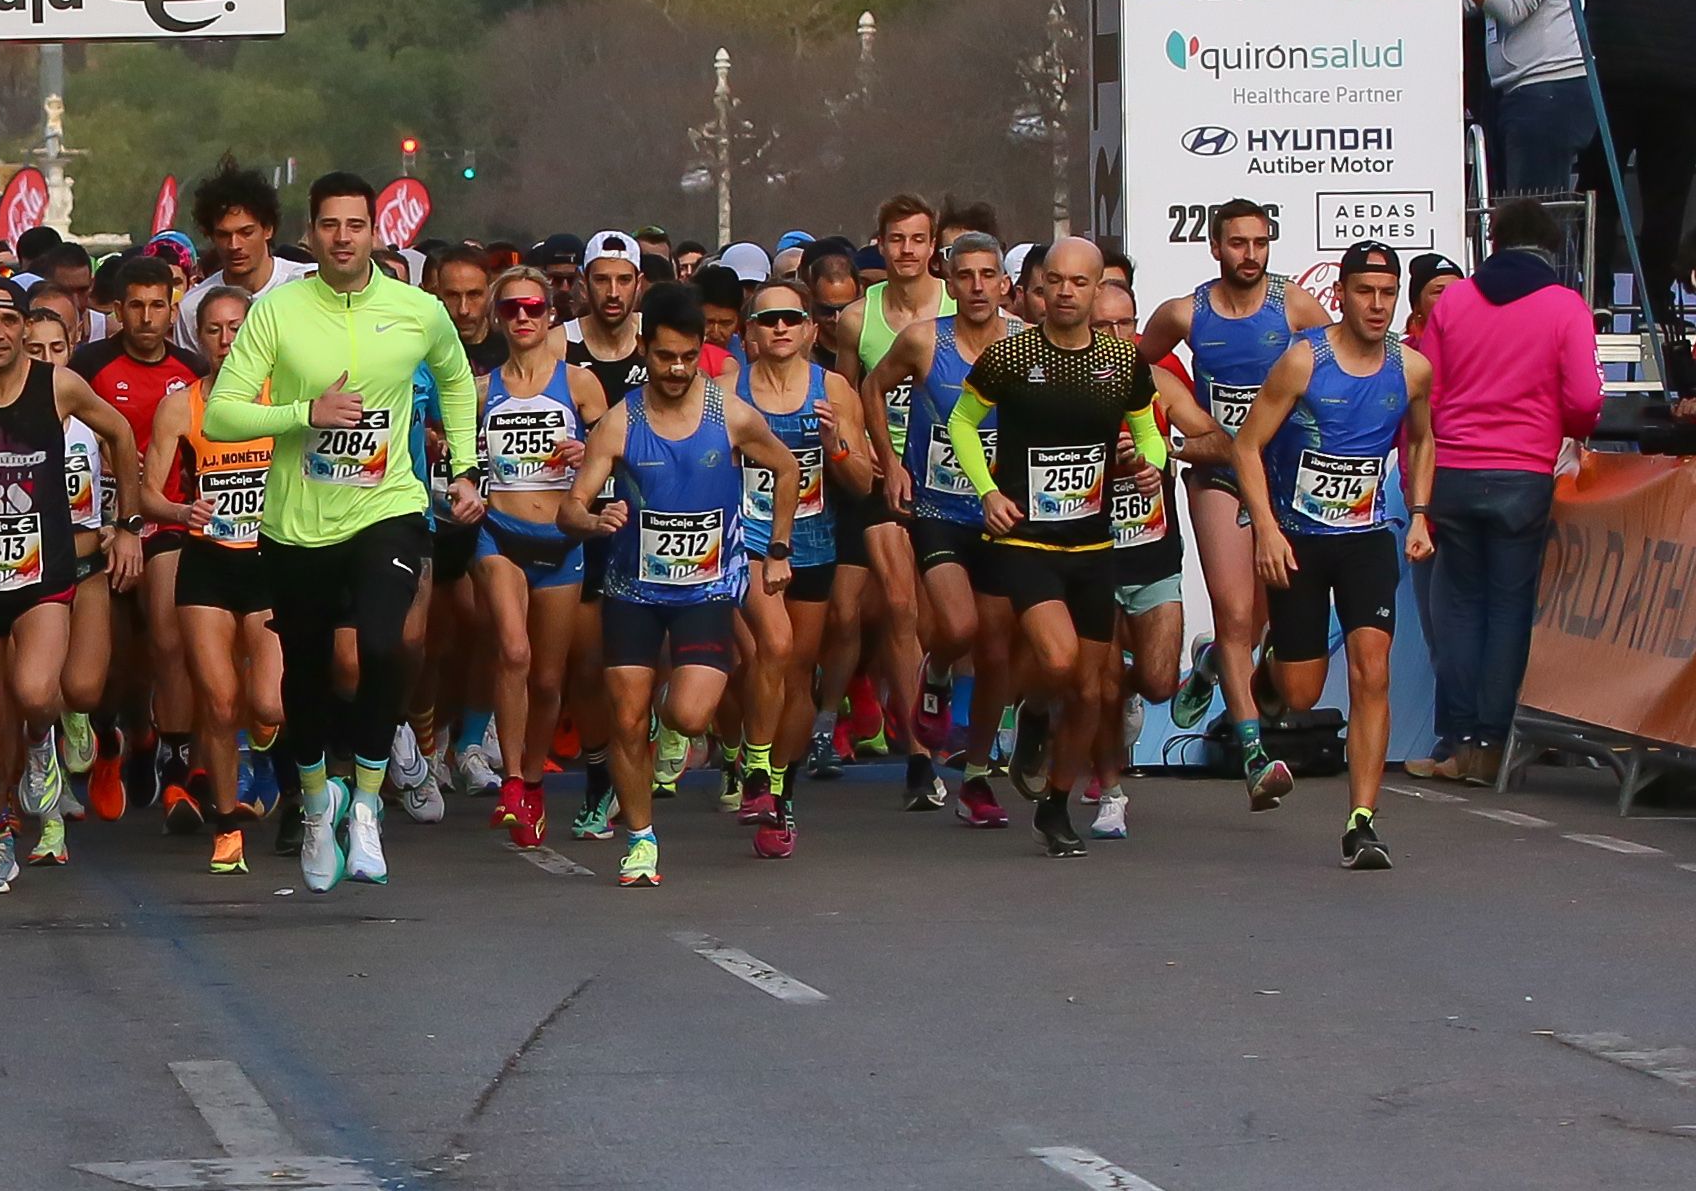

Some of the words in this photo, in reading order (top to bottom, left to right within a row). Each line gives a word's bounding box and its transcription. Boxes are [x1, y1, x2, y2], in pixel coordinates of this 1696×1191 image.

[1201, 38, 1404, 79] quirónsalud
[1233, 88, 1330, 105] Healthcare
[1336, 87, 1404, 104] Partner
[1247, 128, 1393, 151] HYUNDAI
[1247, 157, 1326, 175] Autiber
[1330, 156, 1395, 174] Motor
[1169, 204, 1280, 243] 22S
[1335, 204, 1416, 219] AEDAS
[1335, 224, 1416, 239] HOMES
[1223, 404, 1248, 426] 22
[316, 430, 377, 456] 2084
[502, 430, 555, 455] 2555
[221, 449, 273, 465] MONÉTEA
[1044, 465, 1096, 492] 2550
[1310, 475, 1363, 500] 2314
[1115, 495, 1152, 521] 568
[656, 533, 708, 557] 2312
[1533, 519, 1626, 640] ORLD
